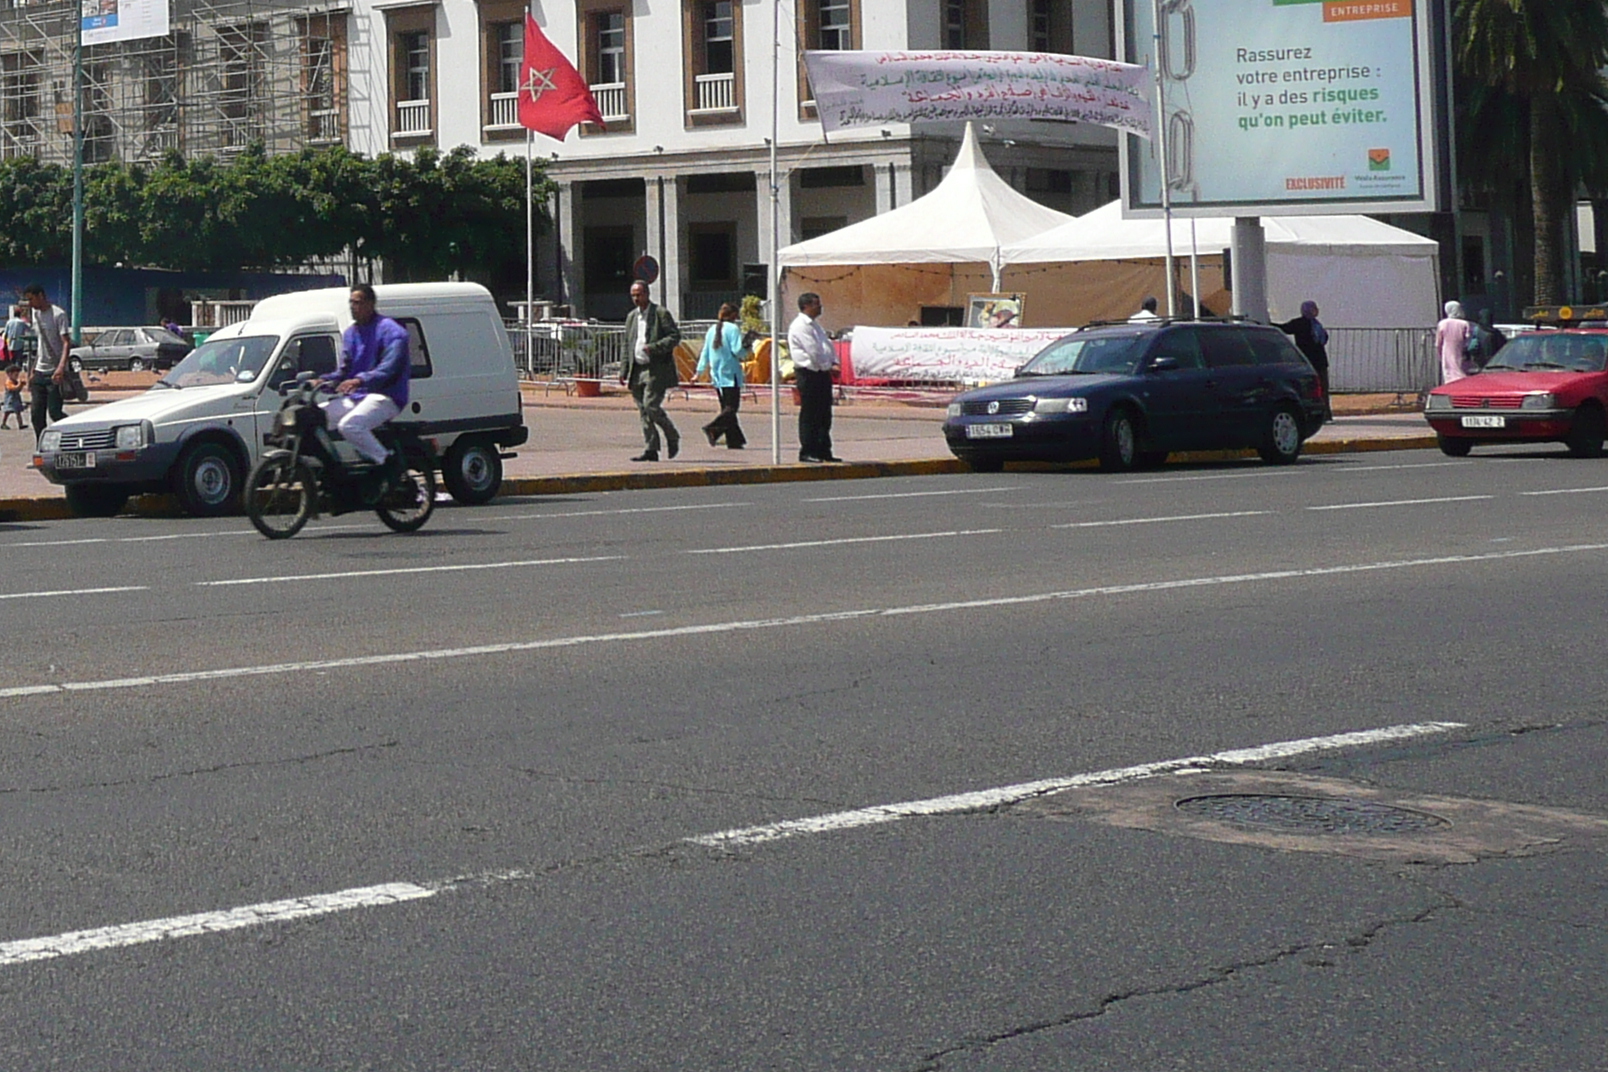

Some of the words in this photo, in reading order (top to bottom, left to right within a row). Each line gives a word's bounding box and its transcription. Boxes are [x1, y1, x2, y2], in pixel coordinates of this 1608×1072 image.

[1330, 2, 1399, 17] ENTREPRISE
[1236, 47, 1312, 63] Rassurez
[1236, 69, 1278, 85] votre
[1282, 64, 1371, 84] entreprise
[1237, 92, 1248, 107] il
[1252, 94, 1262, 110] y
[1265, 93, 1274, 105] a
[1278, 88, 1308, 104] des
[1312, 87, 1379, 104] risques
[1238, 112, 1284, 131] qu'on
[1288, 110, 1328, 129] peut
[1331, 107, 1388, 124] éviter.
[1285, 176, 1345, 191] EXCLUSIVITÉ
